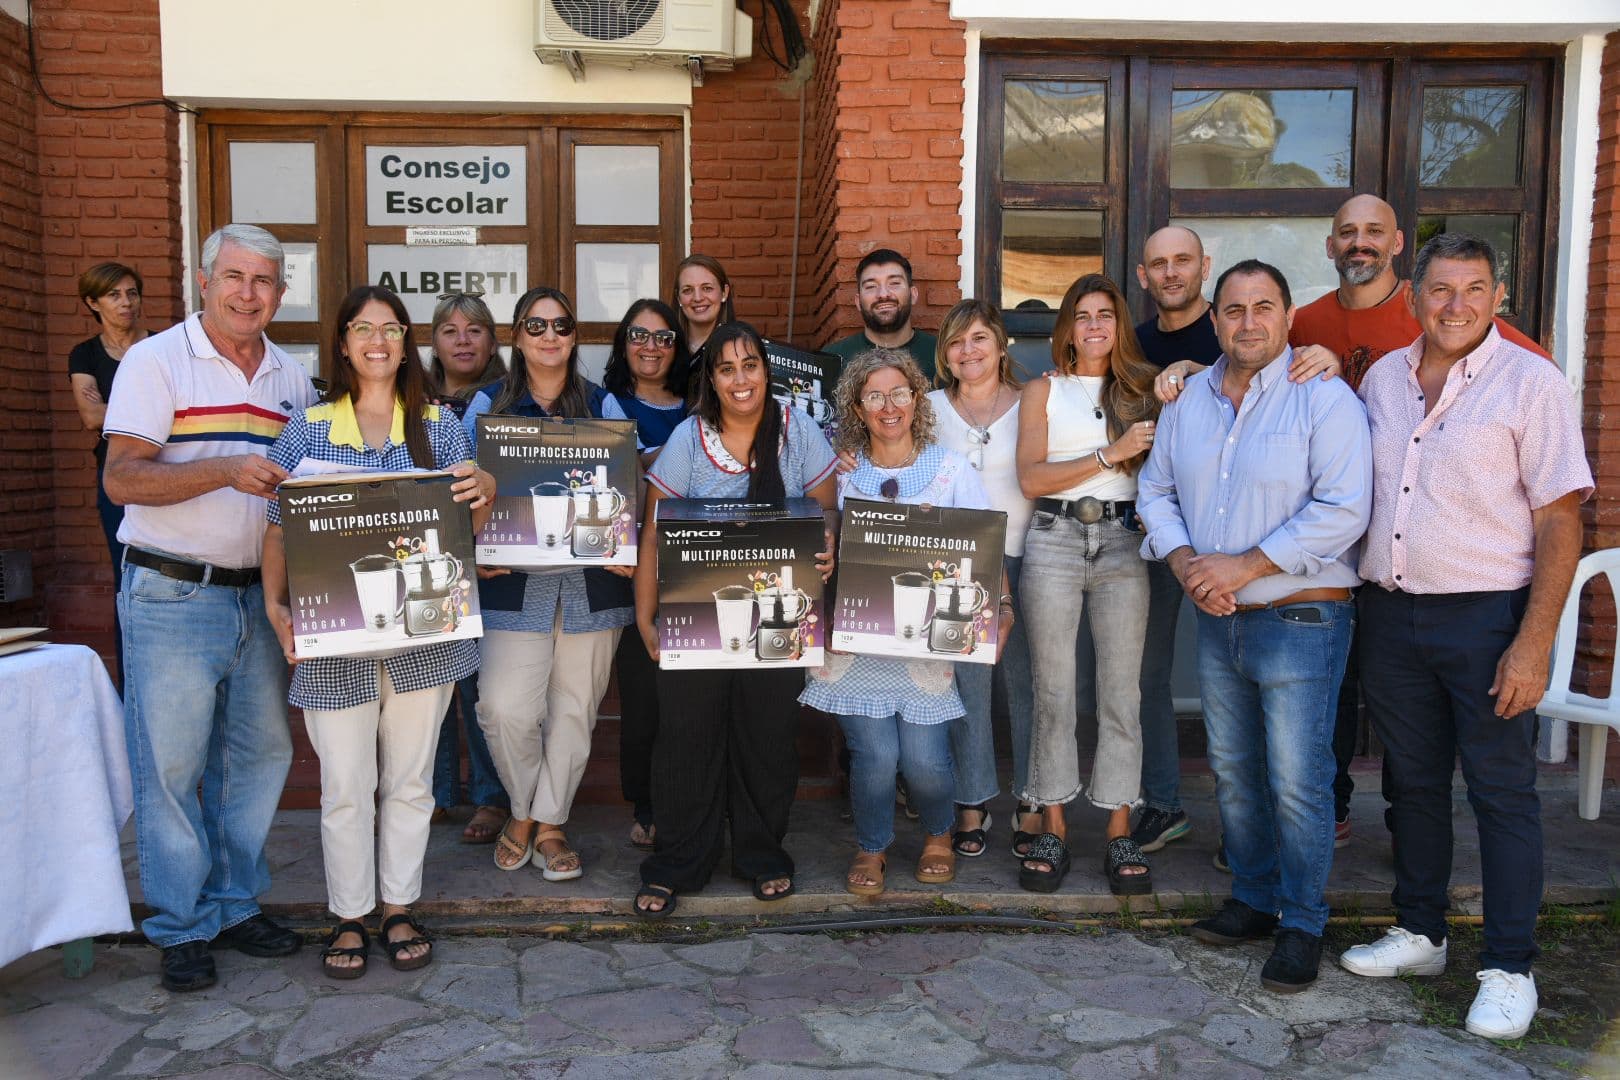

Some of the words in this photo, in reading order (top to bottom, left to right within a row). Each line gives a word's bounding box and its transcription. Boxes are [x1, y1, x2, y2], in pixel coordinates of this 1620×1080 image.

[380, 154, 511, 185] Consejo
[385, 190, 509, 214] Escolar
[378, 271, 519, 295] ALBERTI
[500, 445, 610, 459] MULTIPROCESADORA
[309, 508, 440, 532] MULTIPROCESADORA
[492, 509, 509, 521] IVÍ
[484, 533, 522, 542] HOGAR
[864, 531, 977, 552] MULTIPROCESADORA
[681, 548, 796, 562] MULTIPROCESADORA
[298, 592, 329, 607] VIVÍ
[843, 596, 870, 608] VIVÍ
[300, 609, 315, 618] TU
[842, 609, 856, 618] TU
[302, 617, 347, 632] HOGAR
[667, 615, 693, 626] VIVÍ
[841, 620, 880, 631] HOGAR
[667, 628, 680, 637] TU
[667, 638, 706, 647] HOGAR
